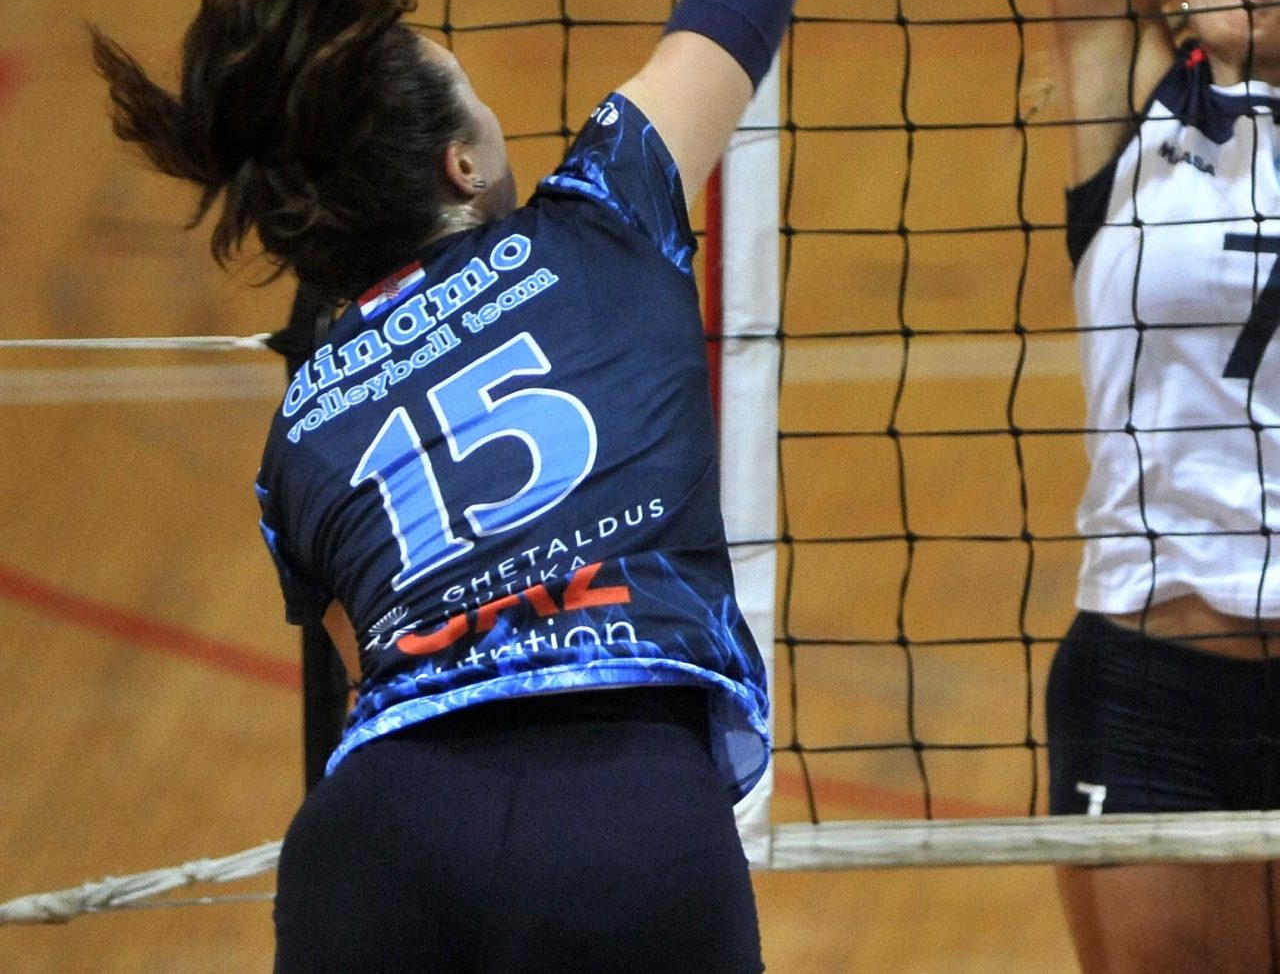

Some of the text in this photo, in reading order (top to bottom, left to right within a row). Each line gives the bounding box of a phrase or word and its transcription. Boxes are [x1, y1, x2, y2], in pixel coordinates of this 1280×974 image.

[282, 233, 533, 419] dinamo
[287, 267, 560, 445] volleyball team
[349, 330, 599, 592] 15
[442, 498, 665, 603] GHETALDUS
